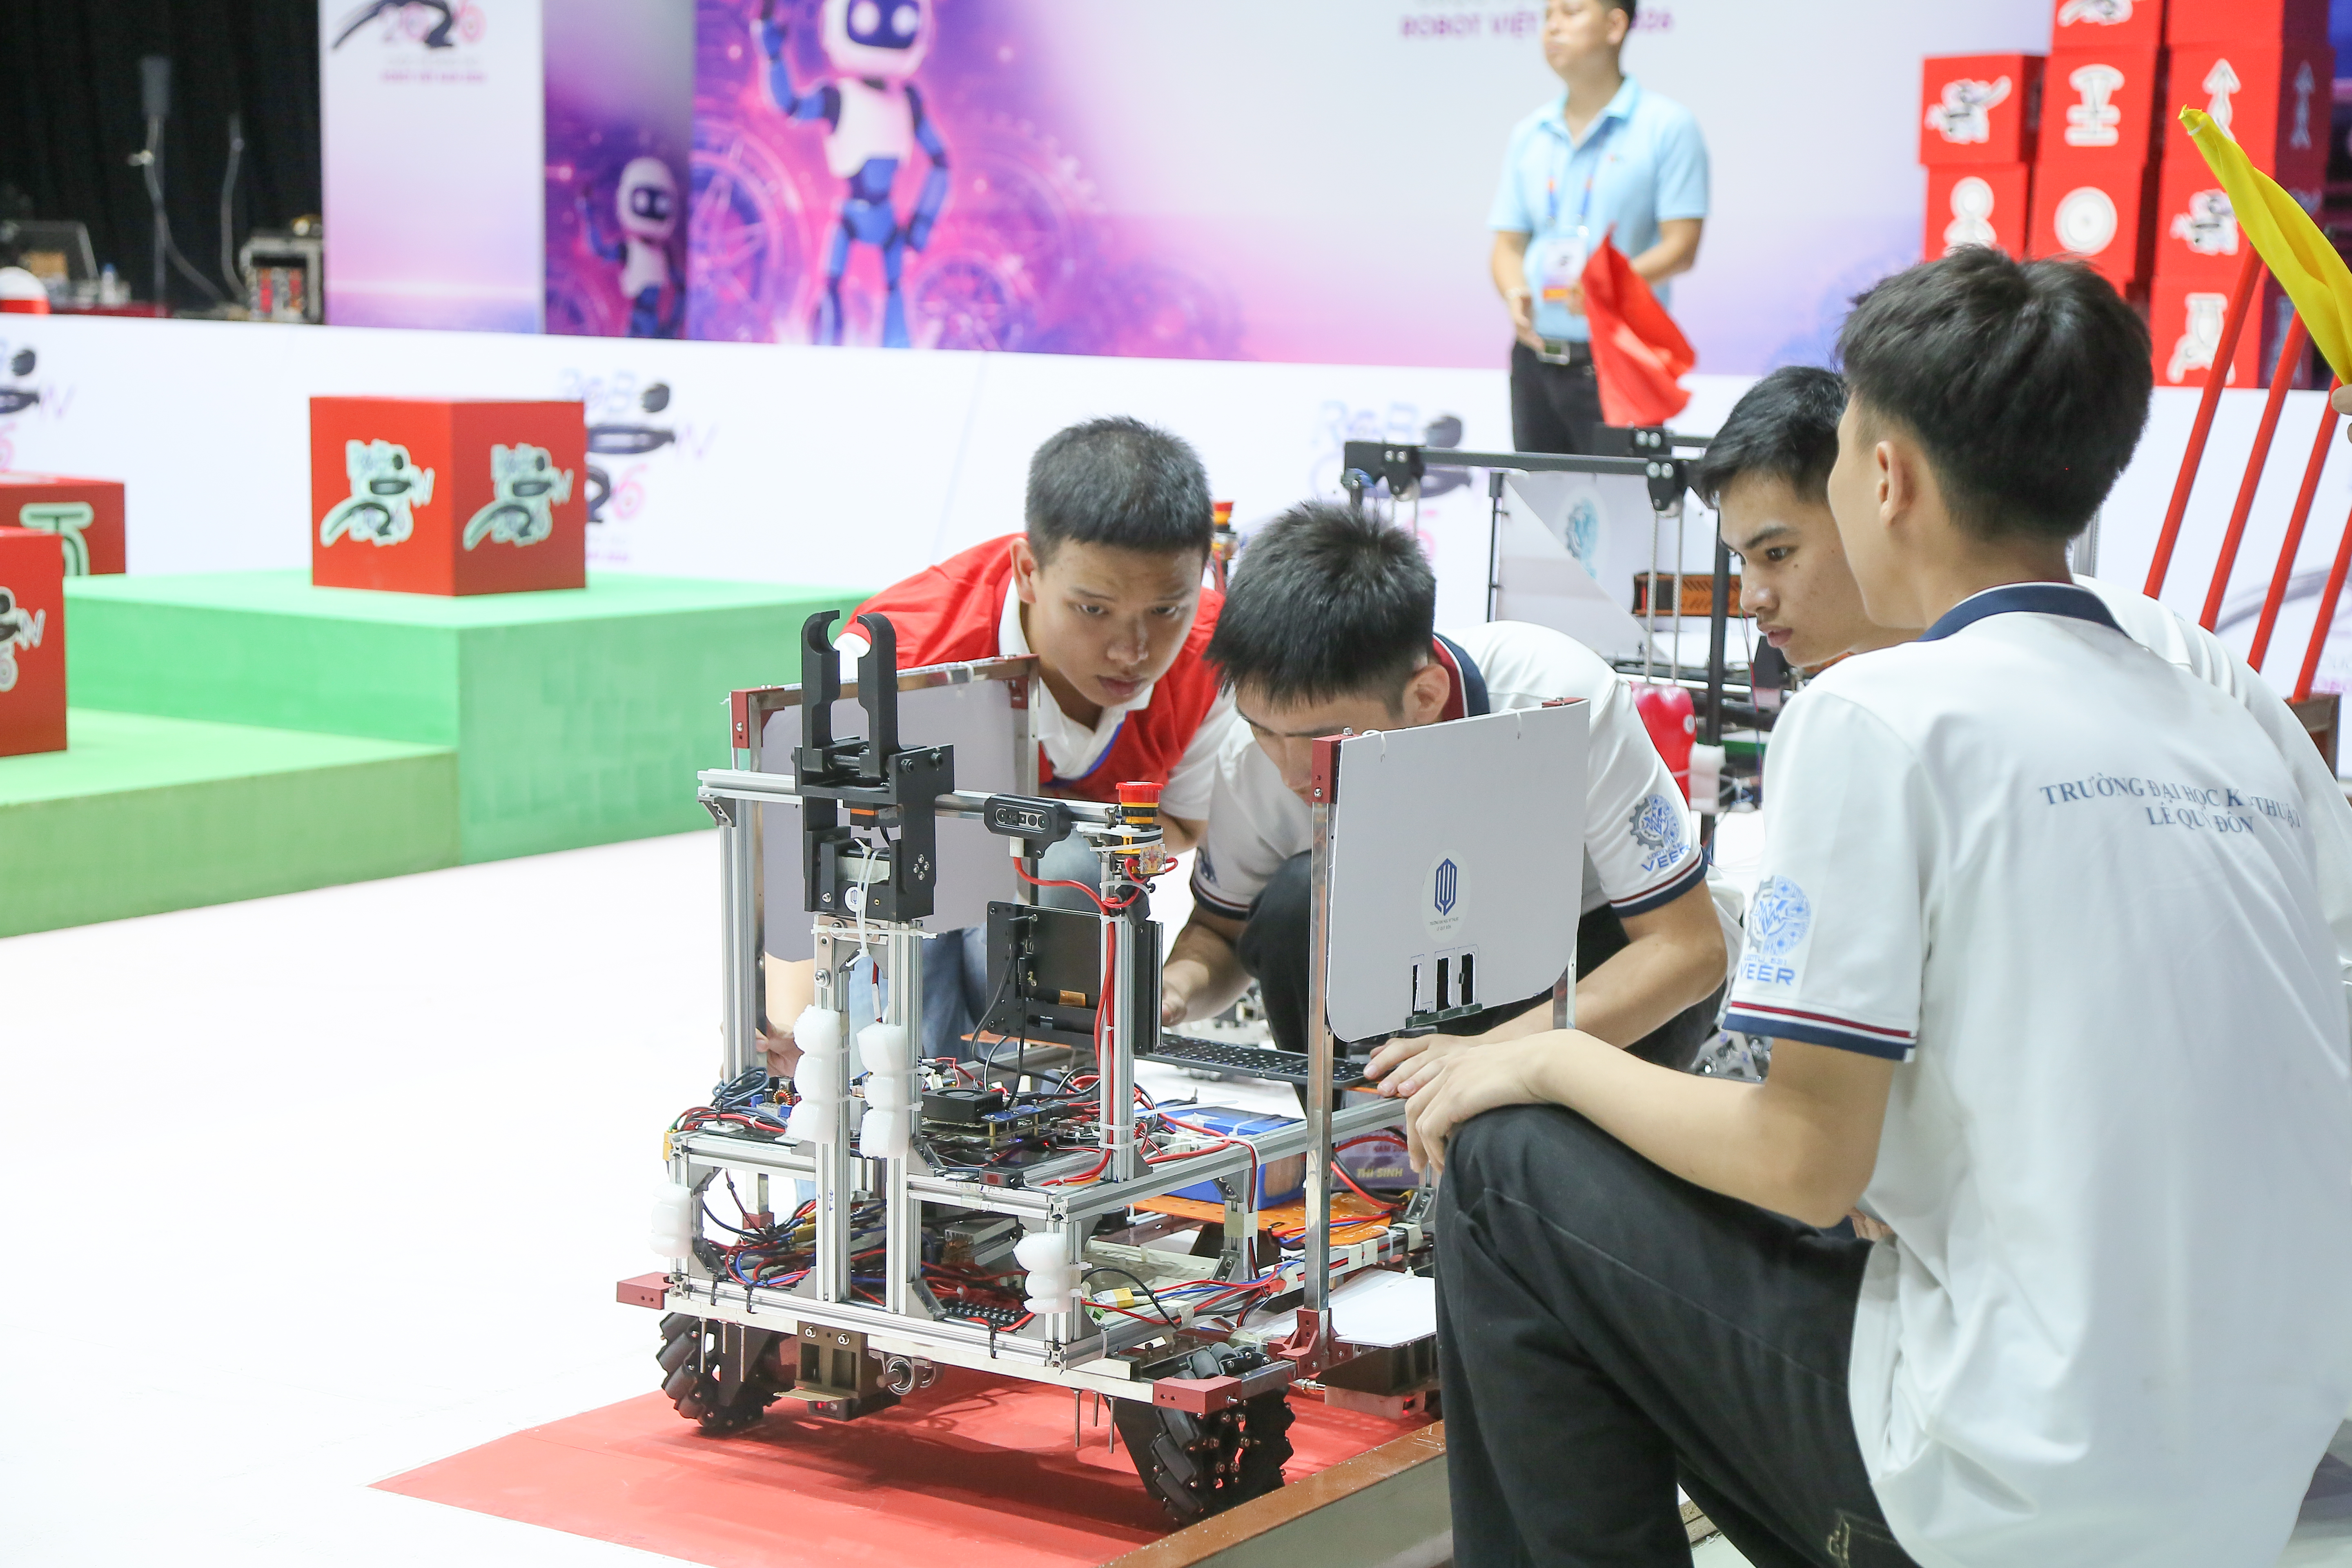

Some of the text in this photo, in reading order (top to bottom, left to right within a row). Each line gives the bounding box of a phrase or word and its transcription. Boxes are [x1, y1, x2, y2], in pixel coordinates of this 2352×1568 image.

[2039, 772, 2145, 805] TRƯỜNG
[2146, 778, 2182, 804] ĐẠI
[2180, 784, 2221, 809] HỌC
[2212, 811, 2254, 833] ĐÔN
[1740, 962, 1795, 985] VEER
[1376, 1168, 1404, 1177] SINH
